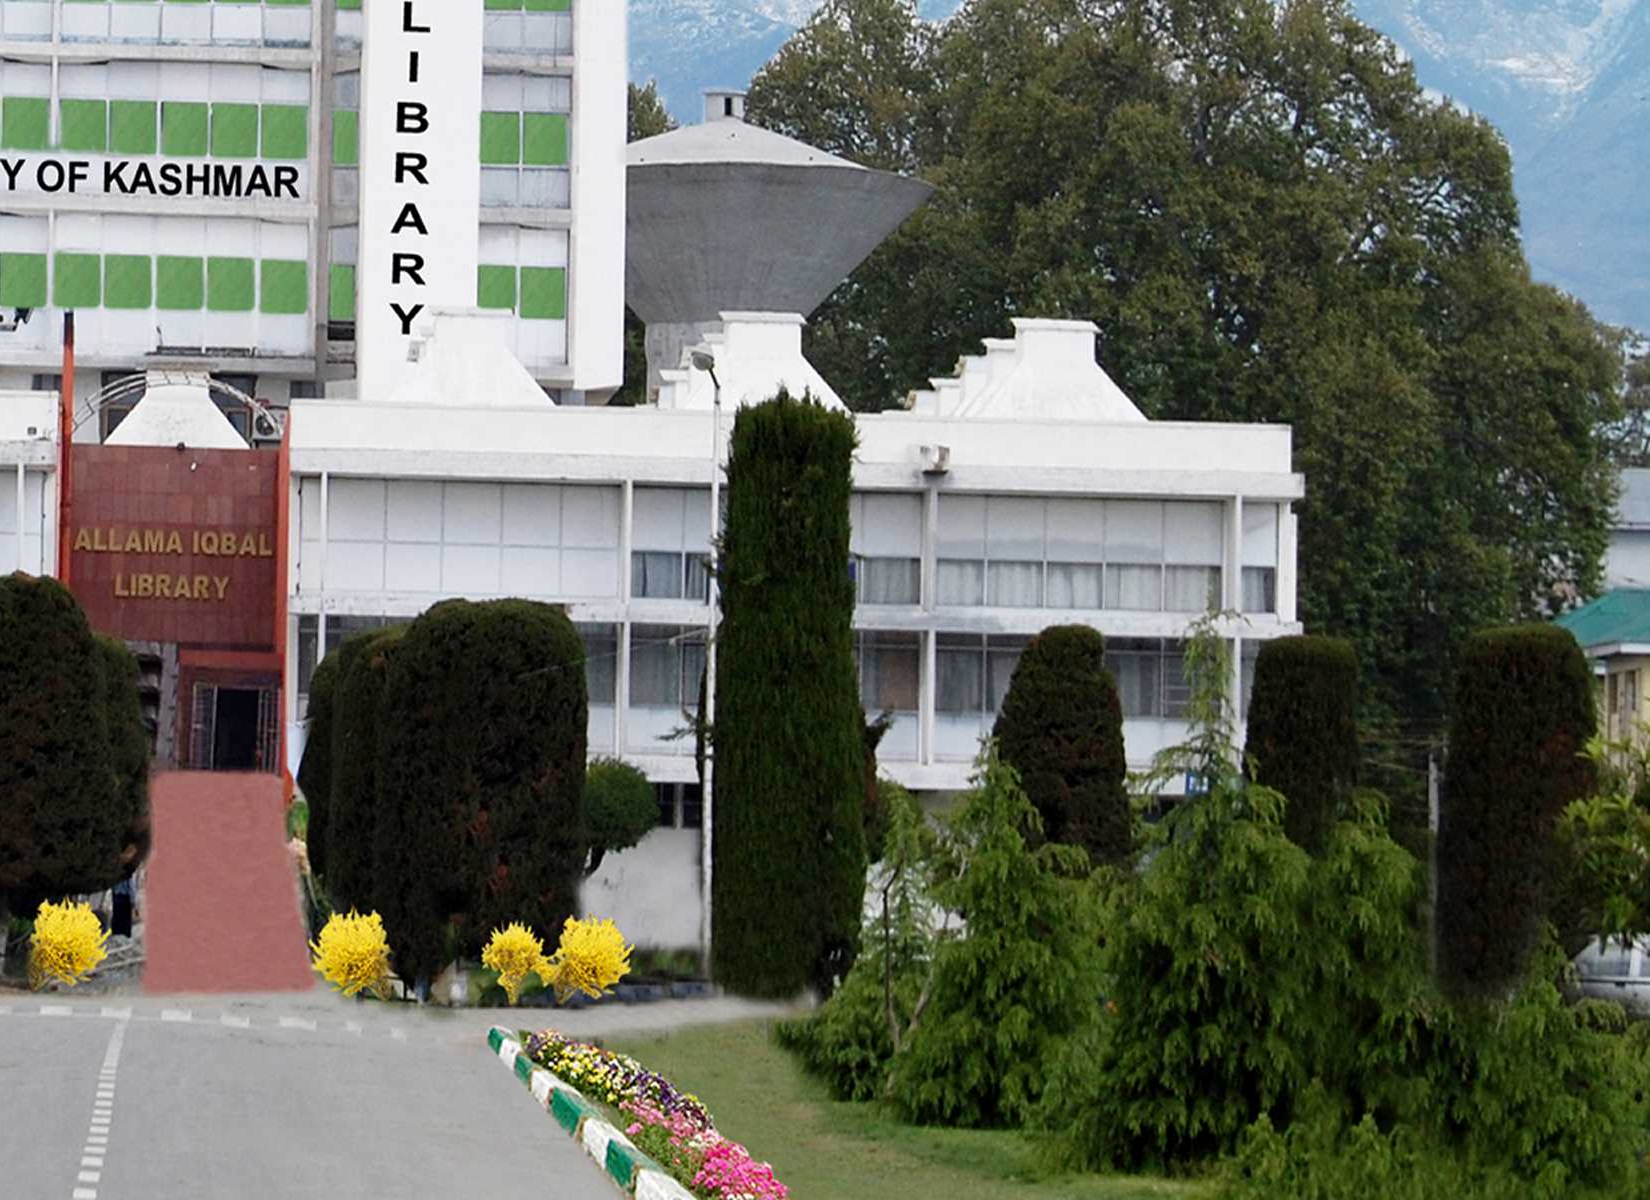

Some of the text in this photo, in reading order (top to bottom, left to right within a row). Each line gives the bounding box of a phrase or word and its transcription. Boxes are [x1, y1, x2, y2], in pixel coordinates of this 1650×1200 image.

[36, 159, 90, 193] OF
[103, 161, 300, 199] KASHMAR
[389, 1, 431, 335] LIBRARY
[73, 527, 273, 556] ALLAMA IQBAL
[115, 573, 231, 600] LIBRARY
